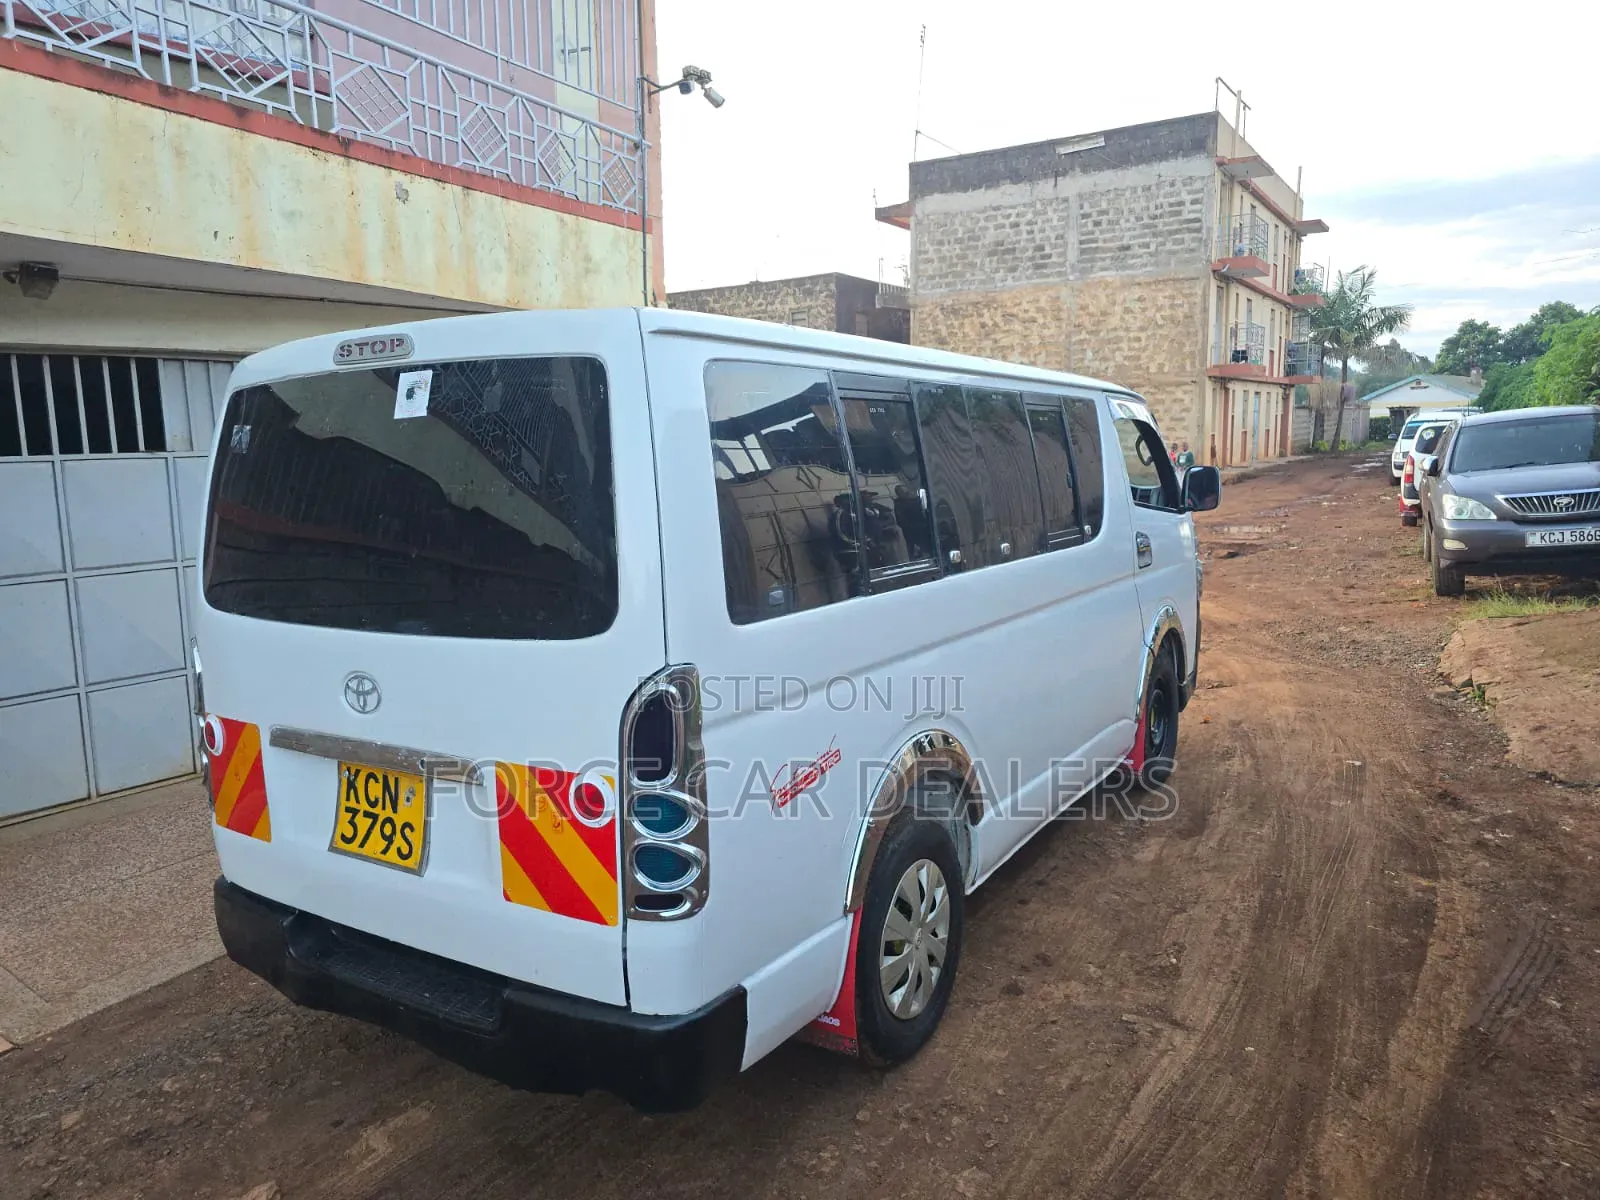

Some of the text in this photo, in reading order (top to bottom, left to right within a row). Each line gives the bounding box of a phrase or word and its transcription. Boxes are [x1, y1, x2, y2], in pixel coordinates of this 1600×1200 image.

[338, 338, 405, 358] STOP
[1540, 531, 1565, 544] KCJ
[345, 766, 399, 814] KCN
[340, 806, 415, 860] 379S
